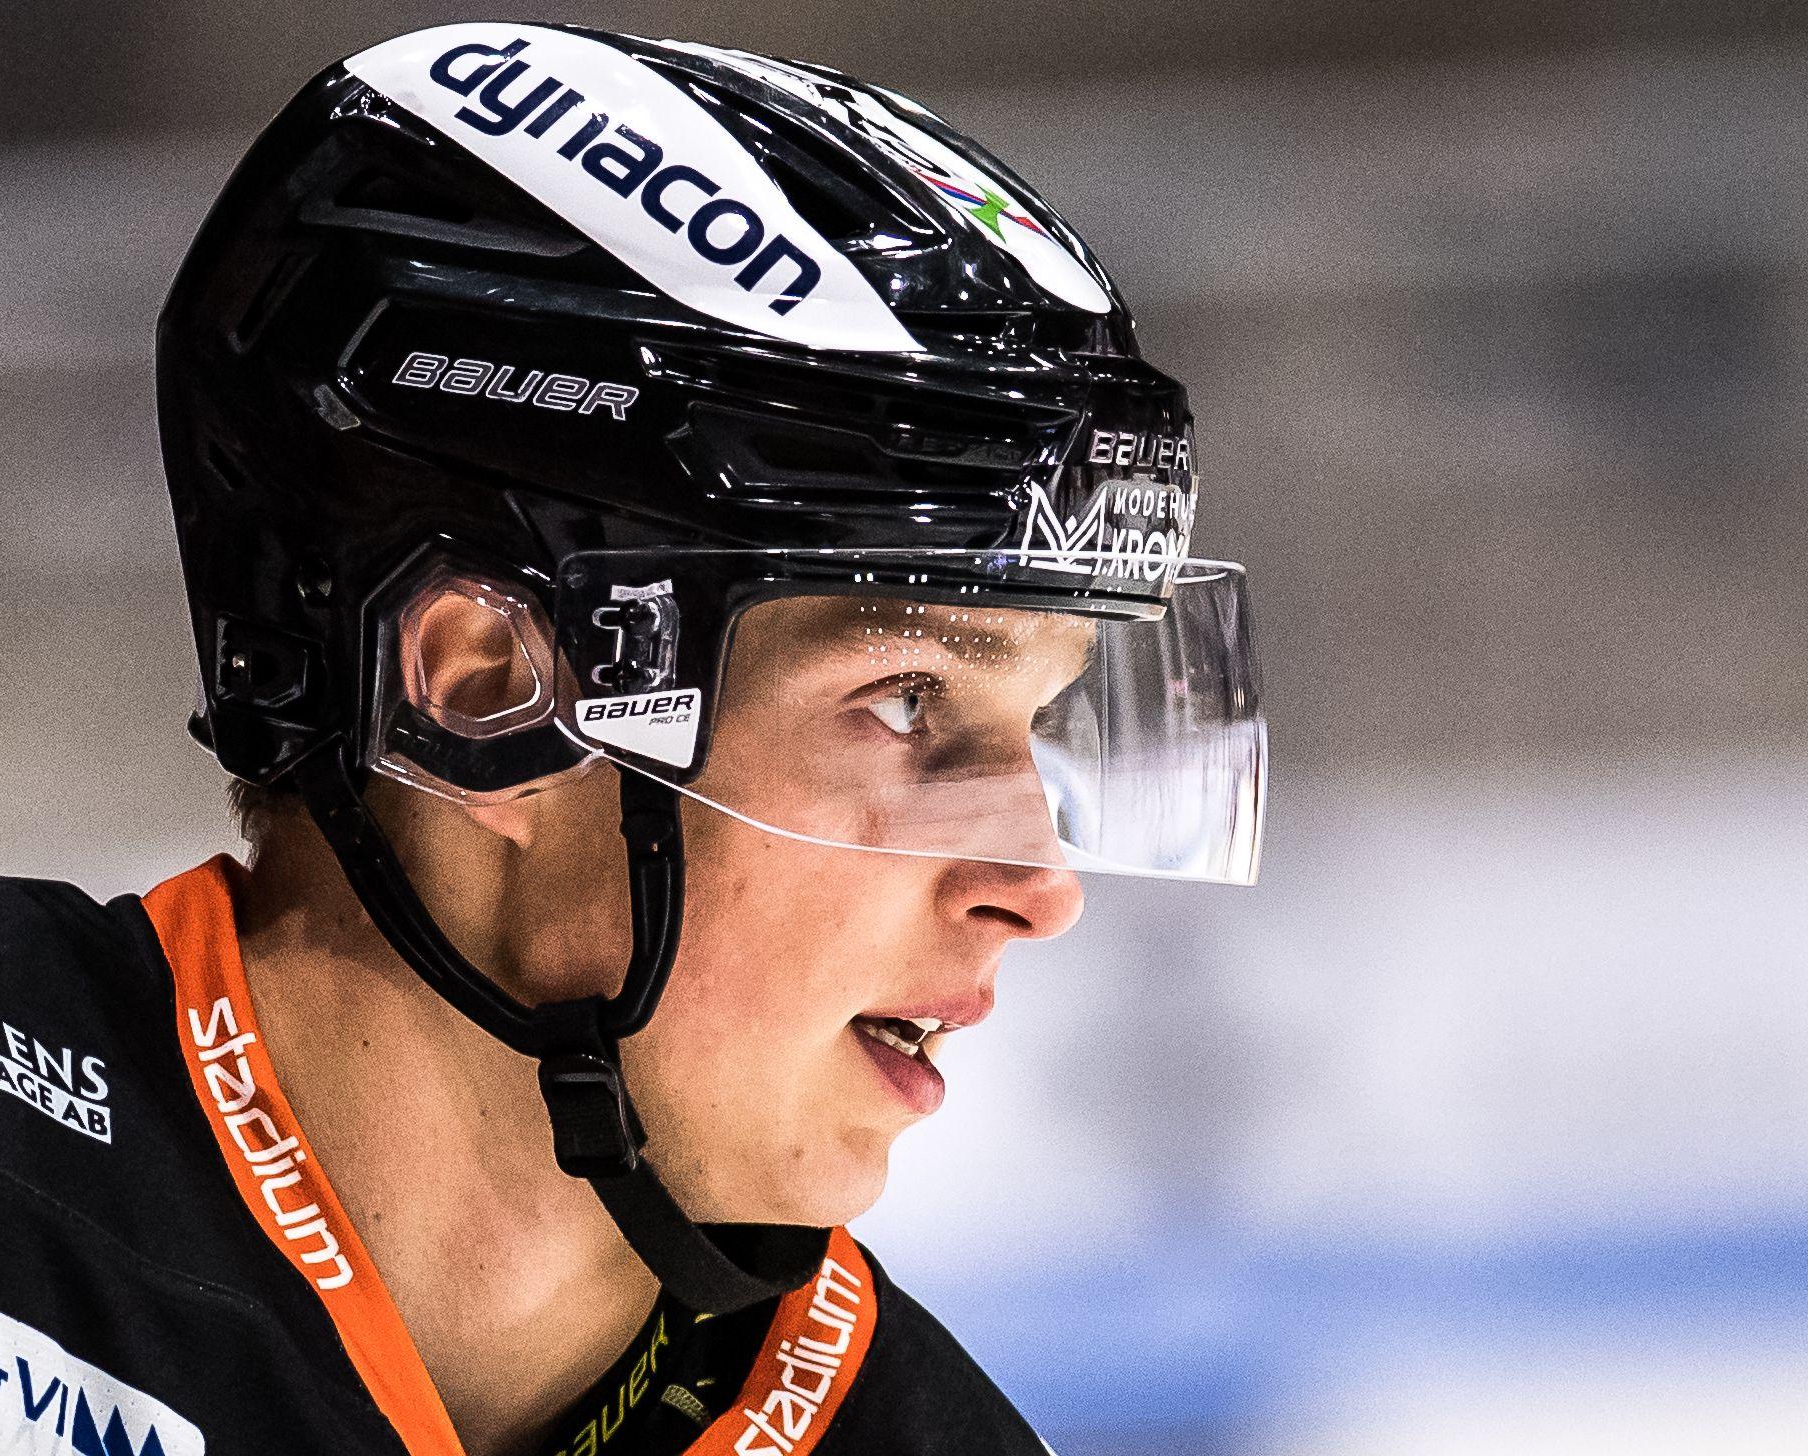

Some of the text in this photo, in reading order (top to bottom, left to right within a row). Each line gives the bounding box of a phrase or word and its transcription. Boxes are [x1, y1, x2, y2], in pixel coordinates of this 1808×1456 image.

[430, 38, 821, 316] dynacon
[393, 352, 639, 421] BAUER
[584, 694, 695, 722] BAUER
[62, 1105, 109, 1136] AB
[187, 996, 354, 1290] stadium
